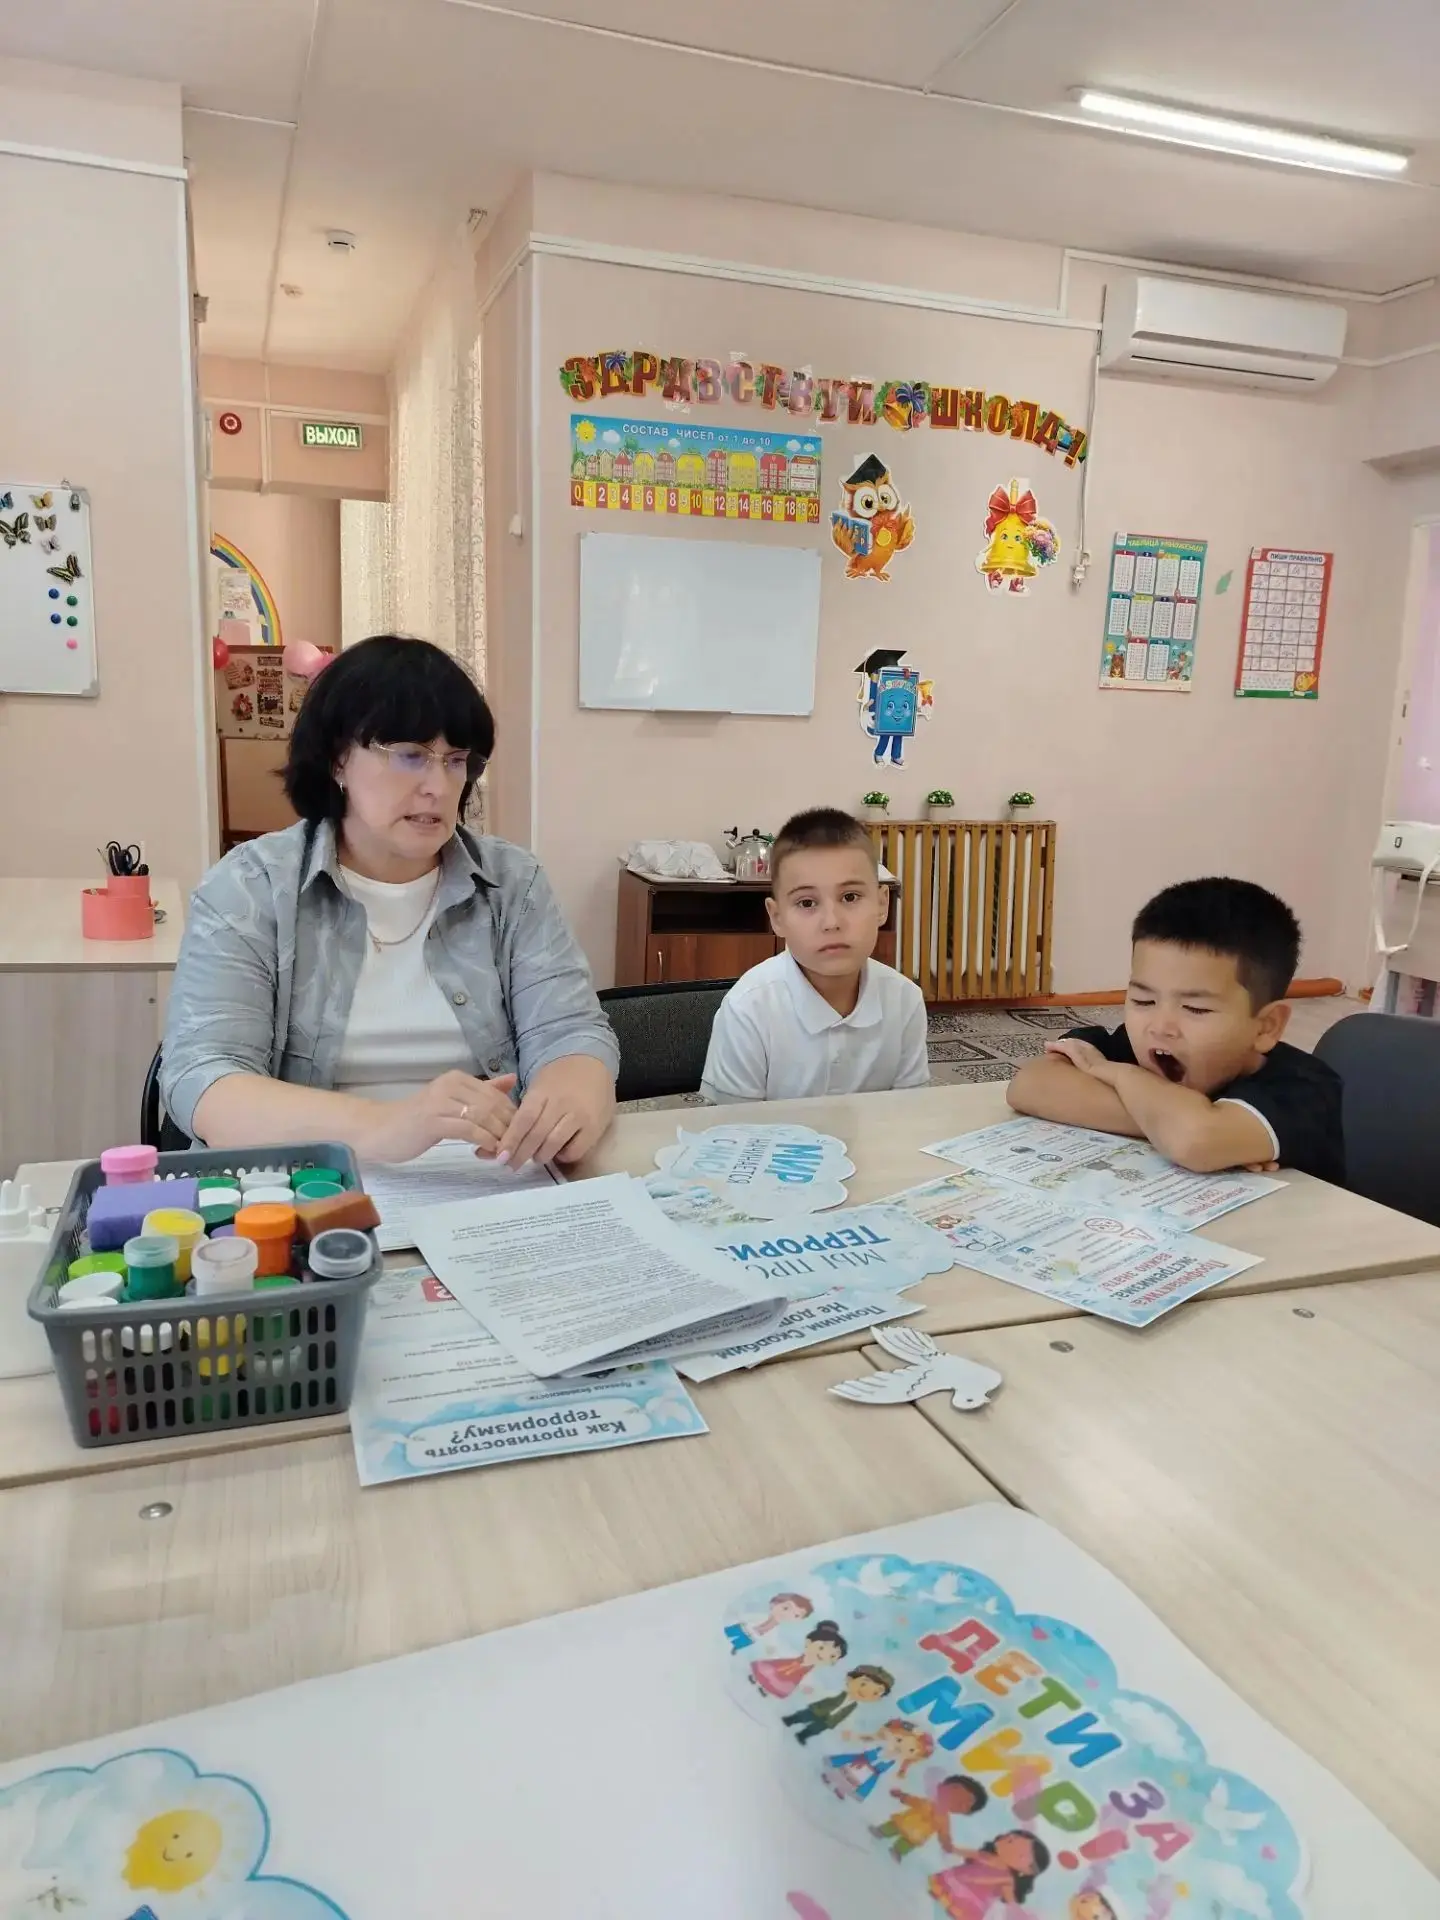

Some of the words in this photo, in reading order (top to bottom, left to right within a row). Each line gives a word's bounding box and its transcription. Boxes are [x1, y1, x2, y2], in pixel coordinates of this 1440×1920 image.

[305, 426, 358, 447] ВЫХОД
[622, 423, 669, 437] СОСТАВ
[676, 429, 714, 441] ЧИСЕЛ
[760, 437, 771, 446] 10
[574, 484, 582, 501] 0
[598, 487, 606, 502] 2
[622, 489, 630, 504] 4
[646, 490, 654, 505] 6
[669, 492, 677, 507] 8
[692, 493, 702, 509] 10
[715, 496, 726, 511] 12
[740, 498, 749, 512] 14
[761, 499, 772, 514] 16
[786, 501, 796, 516] 18
[808, 502, 819, 517] 20
[764, 1143, 824, 1184] МИР
[715, 1225, 891, 1262] ТЕРРОРИ
[820, 1249, 888, 1270] МЫ
[778, 1308, 815, 1328] доп
[802, 1305, 888, 1332] Помним.
[817, 1302, 849, 1314] Не
[450, 1409, 602, 1444] терроризму?
[586, 1420, 627, 1435] Как
[425, 1428, 579, 1458] противостоять
[919, 1619, 1123, 1768] ДЕТИ
[1108, 1779, 1194, 1863] ЗА
[896, 1676, 1132, 1871] МИР!
